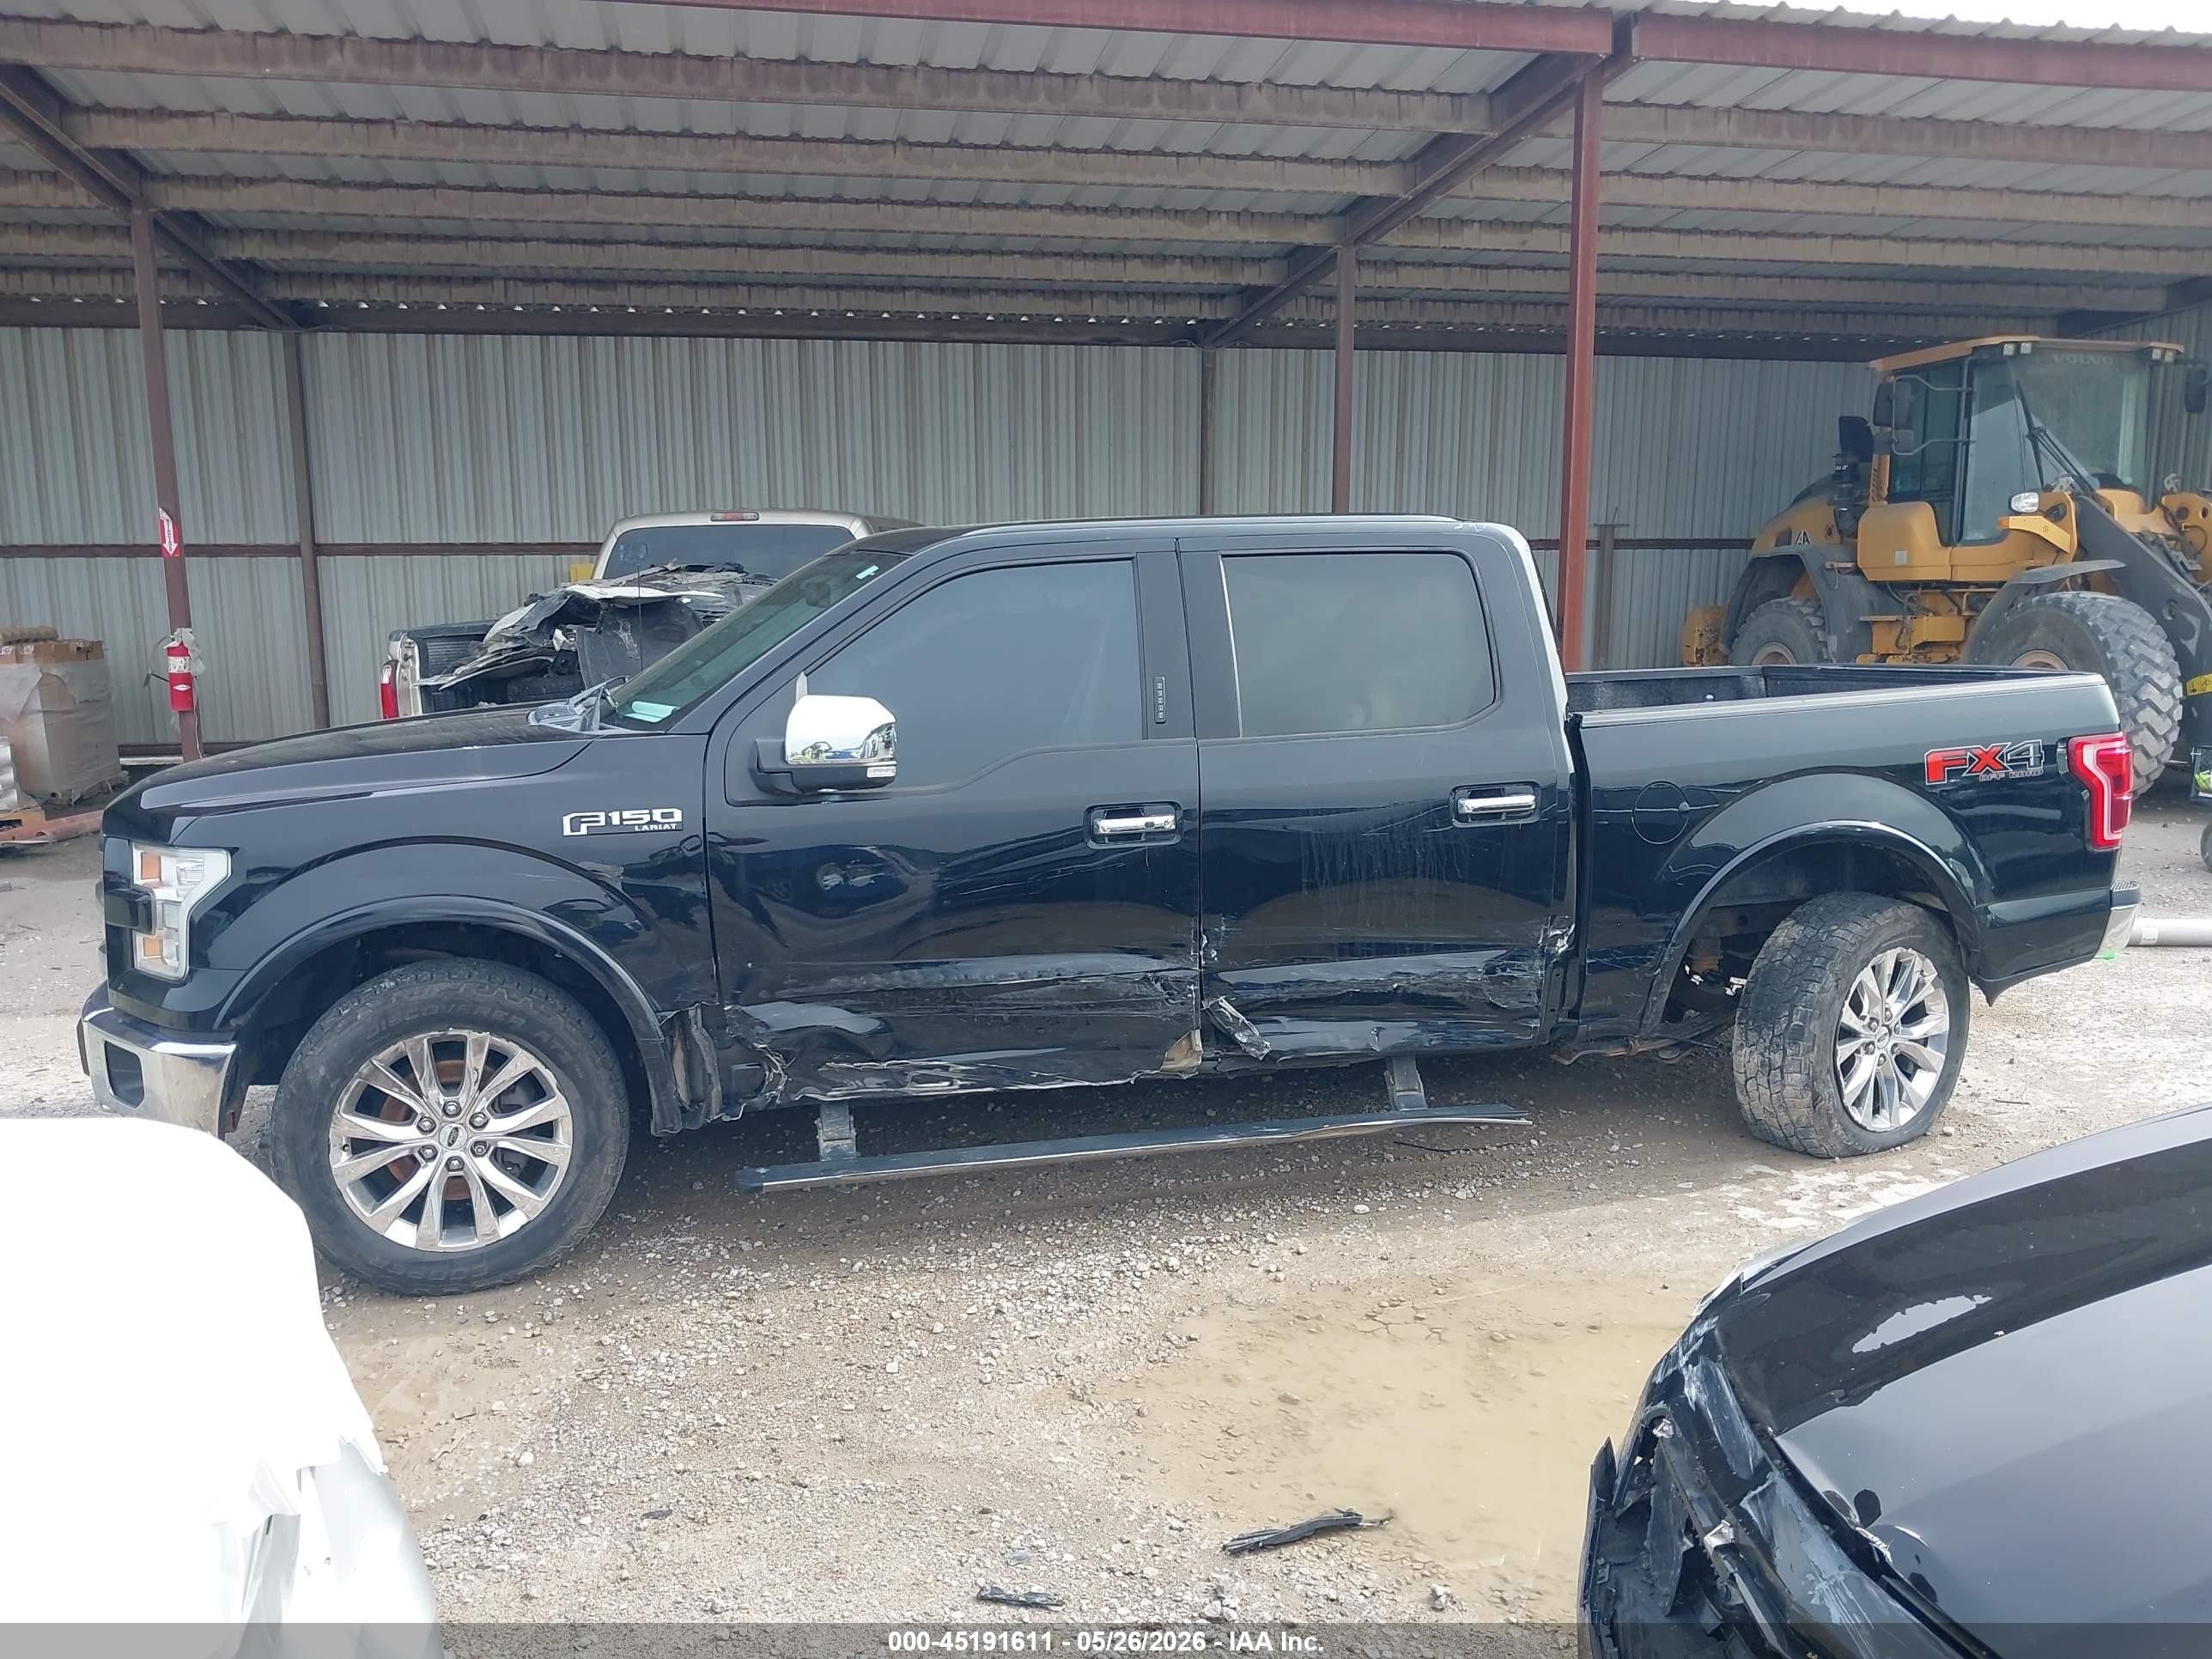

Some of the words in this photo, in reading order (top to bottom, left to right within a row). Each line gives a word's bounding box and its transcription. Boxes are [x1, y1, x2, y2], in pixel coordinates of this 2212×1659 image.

[1923, 739, 2045, 786] FX4
[1978, 773, 2006, 782] OFF
[2008, 769, 2044, 780] ROAD
[635, 823, 678, 832] LARIAT
